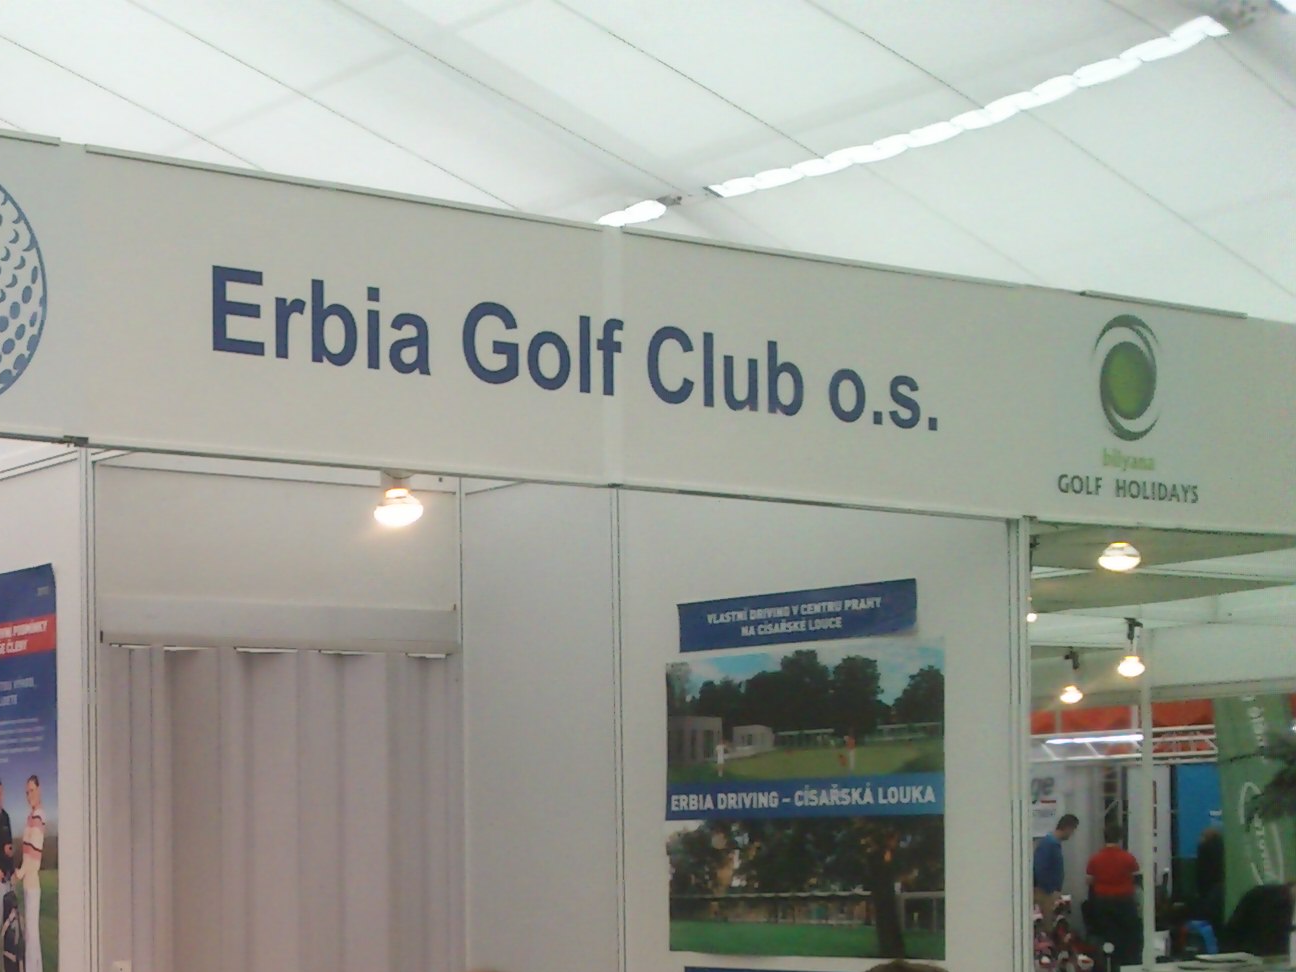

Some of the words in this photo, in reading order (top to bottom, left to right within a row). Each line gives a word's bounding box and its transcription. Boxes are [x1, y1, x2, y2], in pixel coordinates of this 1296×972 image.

[211, 265, 431, 376] Erbia
[461, 301, 622, 397] Golf
[646, 325, 805, 417] Club
[828, 367, 939, 432] o.s.
[1058, 474, 1103, 496] GOLF
[1116, 478, 1199, 504] HOLIDAYS
[750, 606, 791, 621] DRIVING
[800, 601, 843, 617] CENTRU
[671, 793, 714, 811] ERBIA
[717, 790, 779, 810] DRIVING
[878, 786, 936, 804] LOUKA
